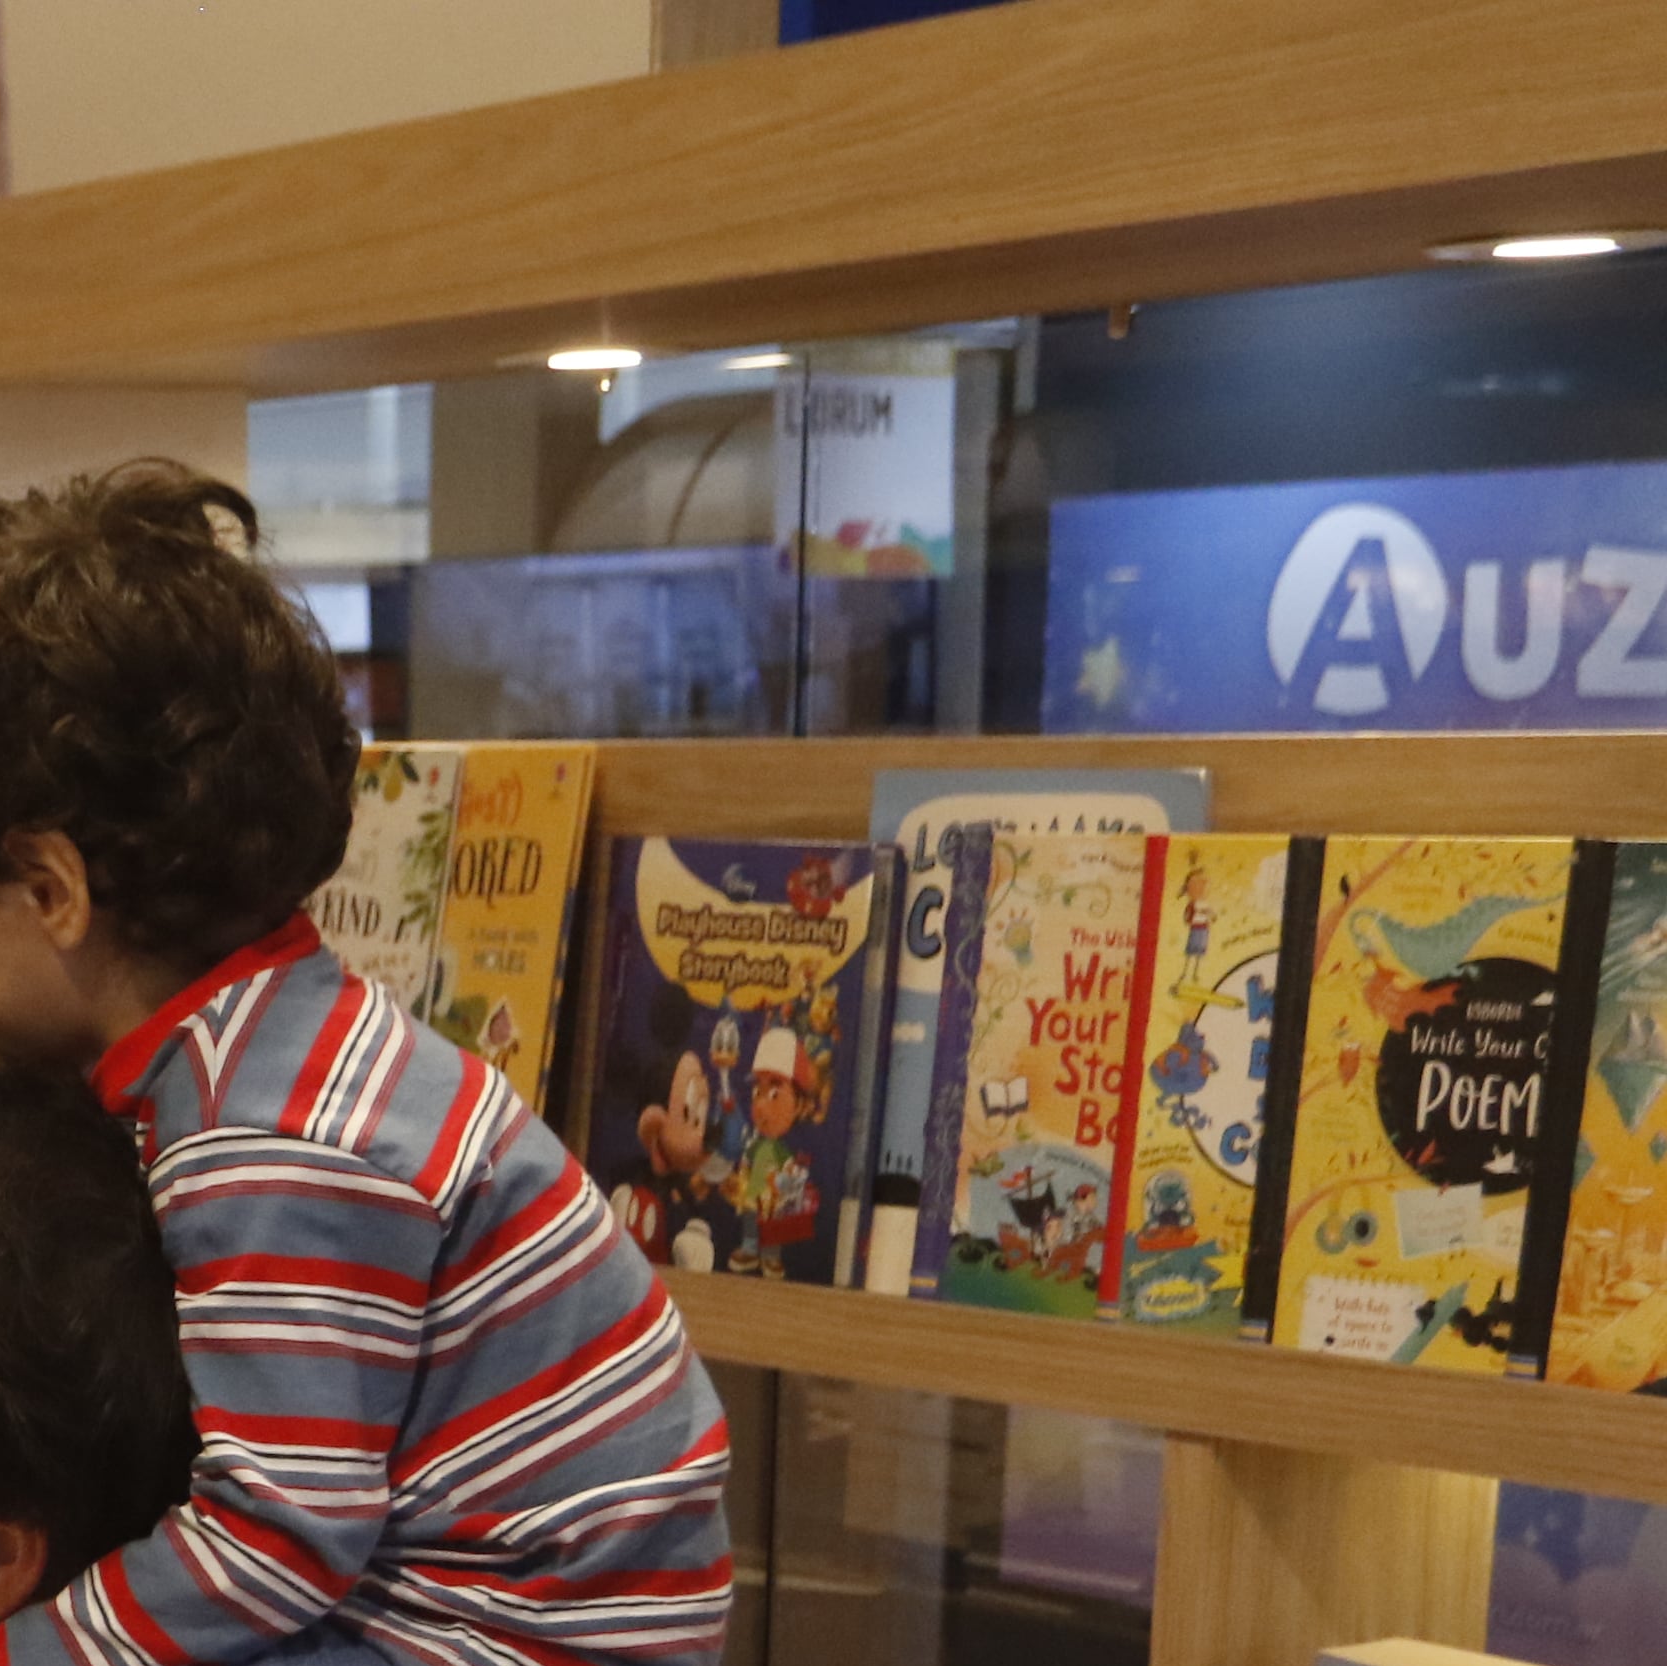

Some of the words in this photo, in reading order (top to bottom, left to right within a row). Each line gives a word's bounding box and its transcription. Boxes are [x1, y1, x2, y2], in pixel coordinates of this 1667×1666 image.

[454, 836, 543, 909] ORED
[657, 902, 766, 949] Playhouse
[768, 909, 849, 957] Disney
[678, 949, 790, 993] Storybook
[1025, 996, 1122, 1046] Your
[1410, 1024, 1466, 1056] Write
[1475, 1027, 1523, 1060] Your
